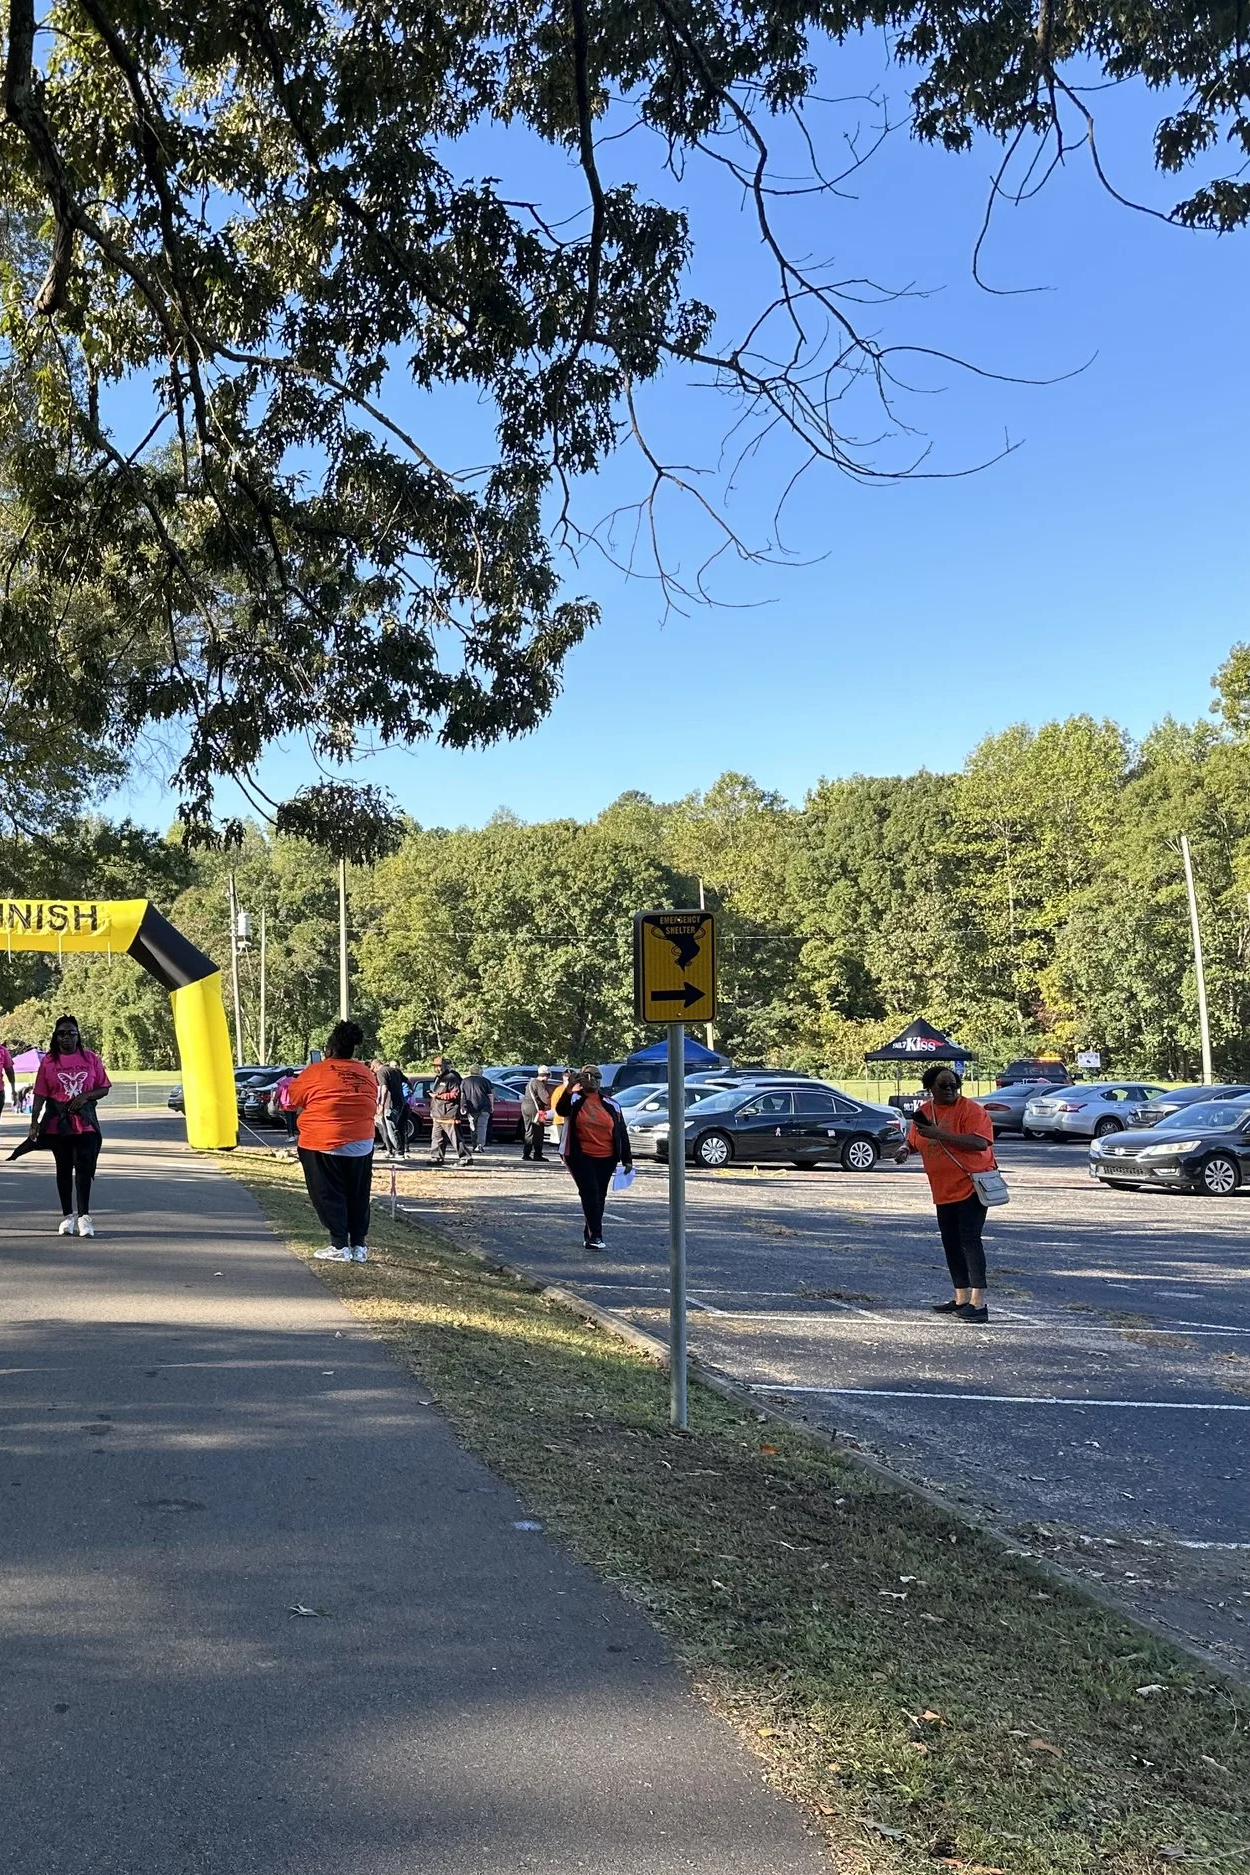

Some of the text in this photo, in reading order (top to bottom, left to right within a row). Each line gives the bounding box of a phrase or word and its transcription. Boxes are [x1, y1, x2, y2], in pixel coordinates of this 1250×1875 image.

[659, 915, 701, 925] EMERGENCY
[665, 926, 696, 935] SHELTER
[905, 1036, 936, 1051] Kiss
